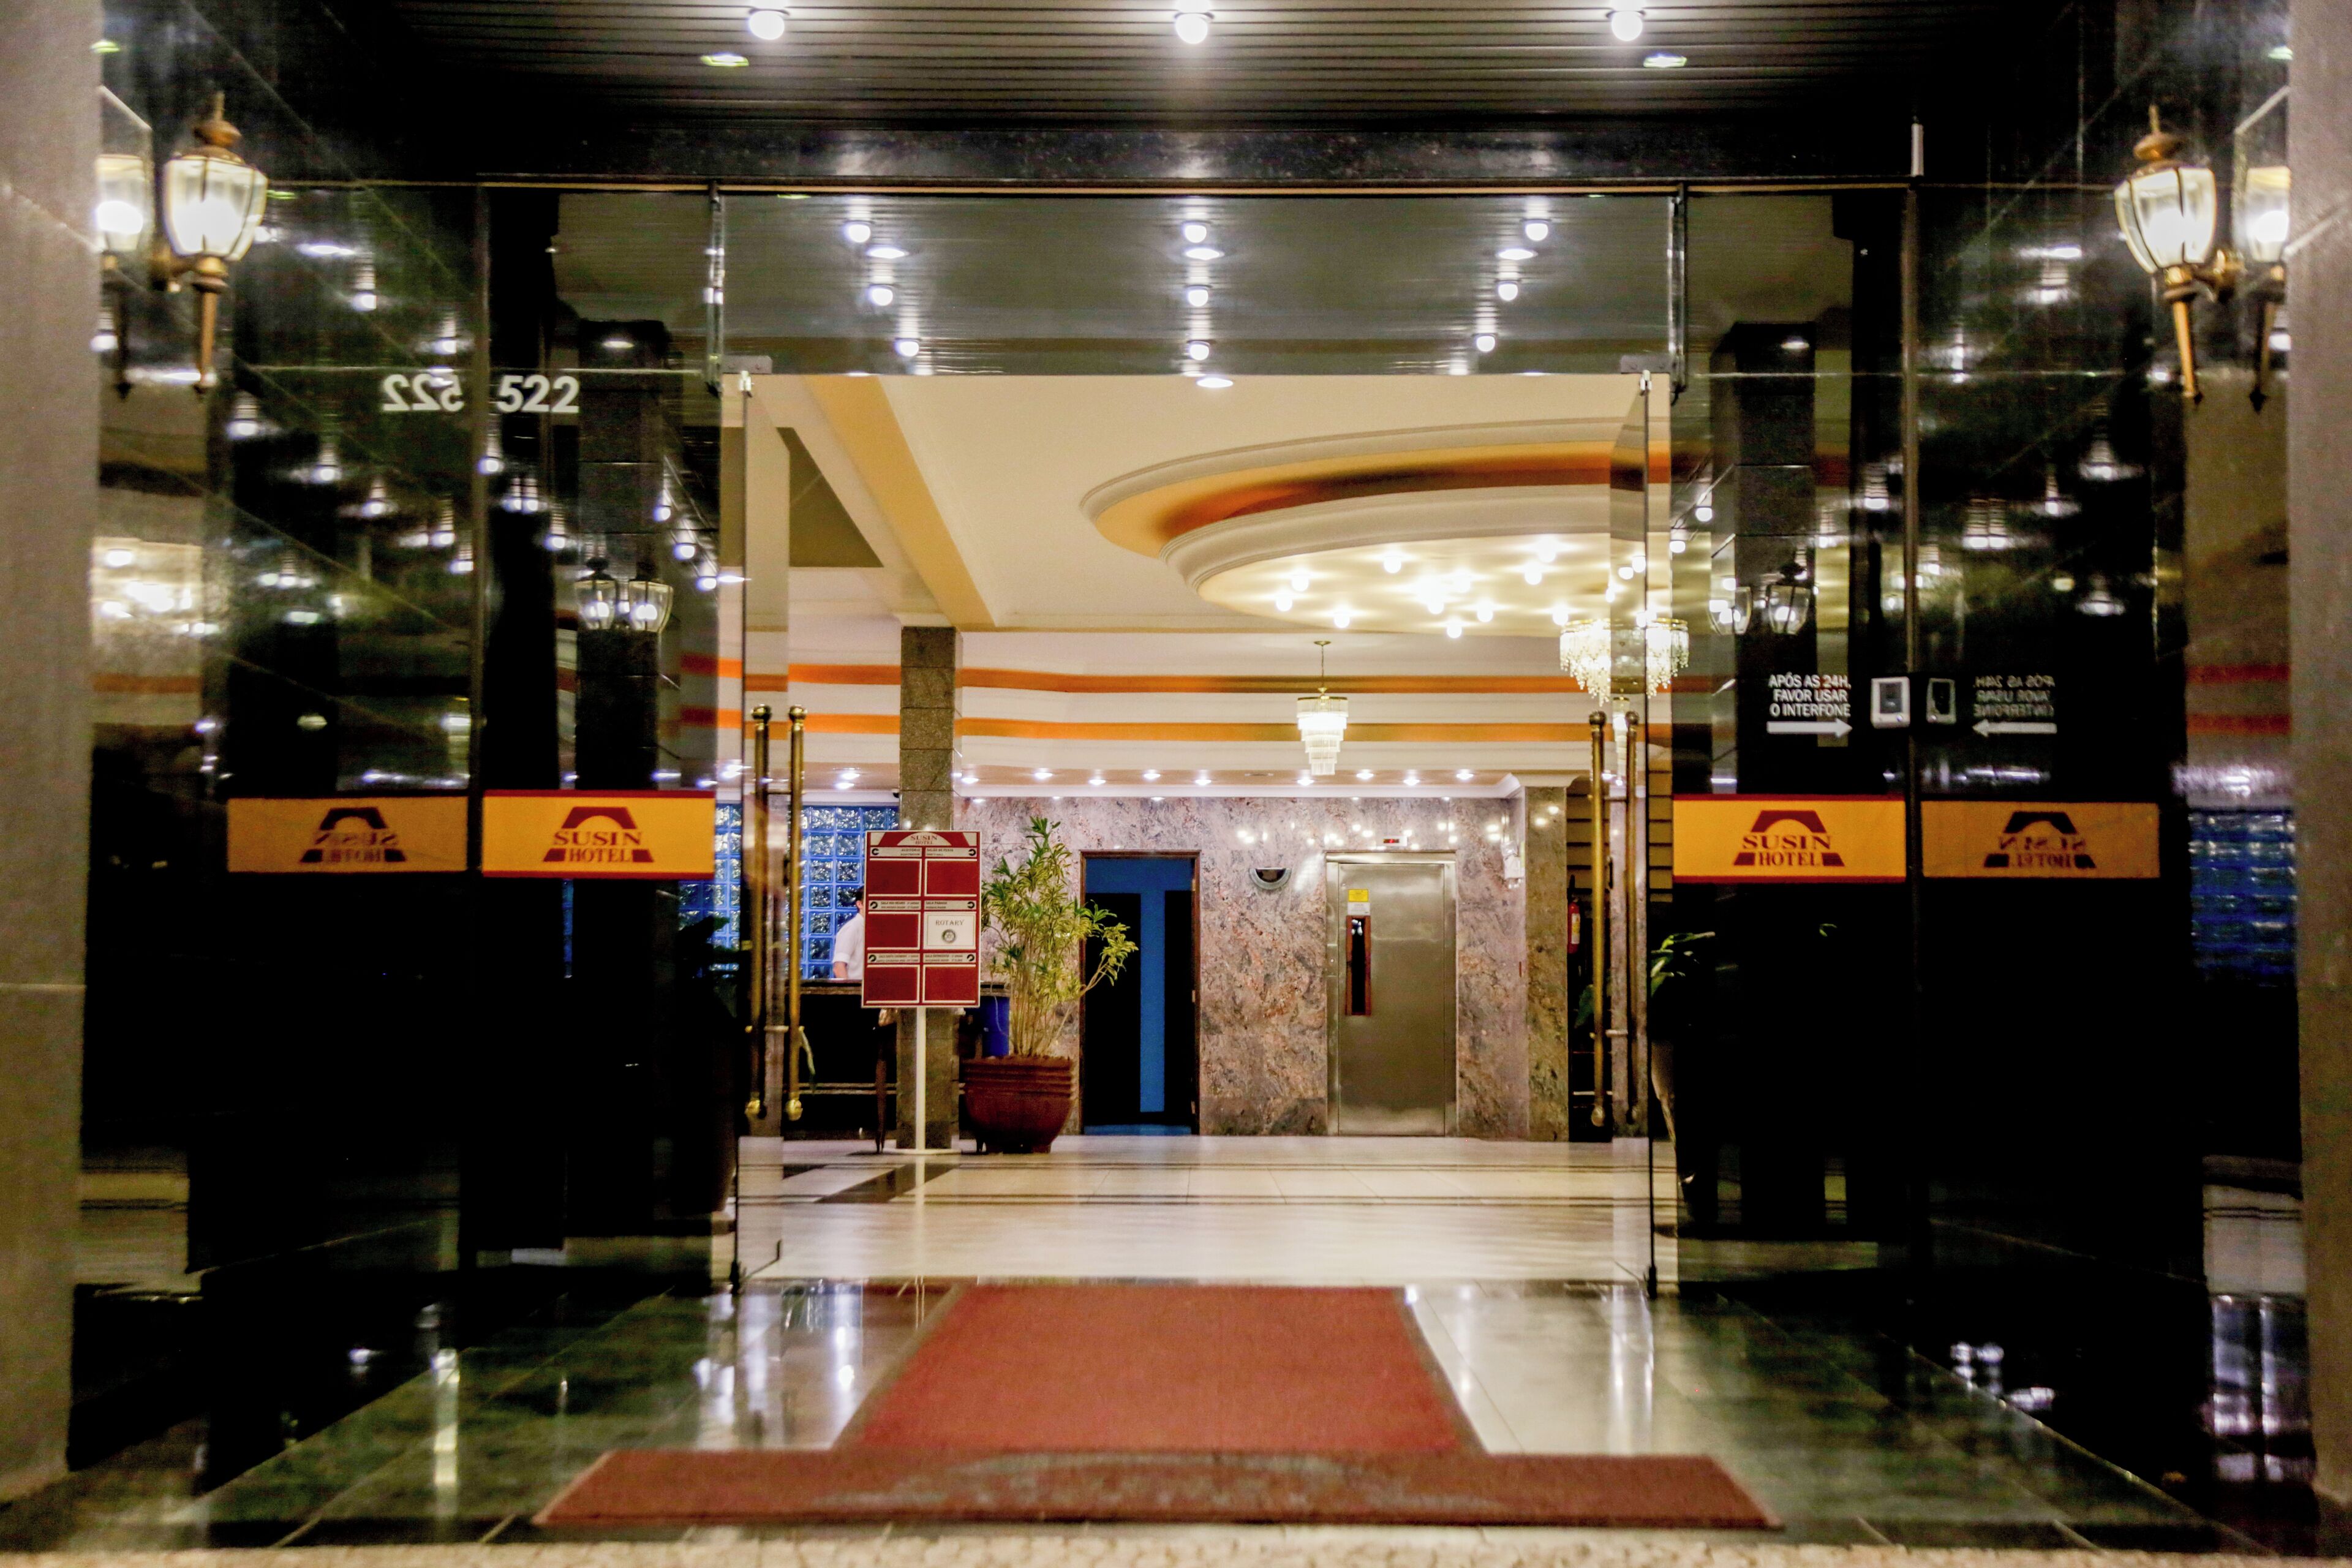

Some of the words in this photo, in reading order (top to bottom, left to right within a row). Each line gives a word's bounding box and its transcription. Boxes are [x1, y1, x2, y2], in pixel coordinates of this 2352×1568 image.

[497, 374, 579, 413] 522
[1768, 671, 1802, 688] APÓS
[1803, 674, 1820, 688] AS
[1773, 688, 1812, 703] FAVOR
[1814, 688, 1848, 703] USAR
[1769, 703, 1781, 717] O
[1782, 703, 1851, 717] INTERFONE
[552, 829, 643, 846] SUSIN
[1742, 834, 1833, 851] SUSIN
[568, 848, 632, 863] HOTEL
[1758, 851, 1823, 867] HOTEL
